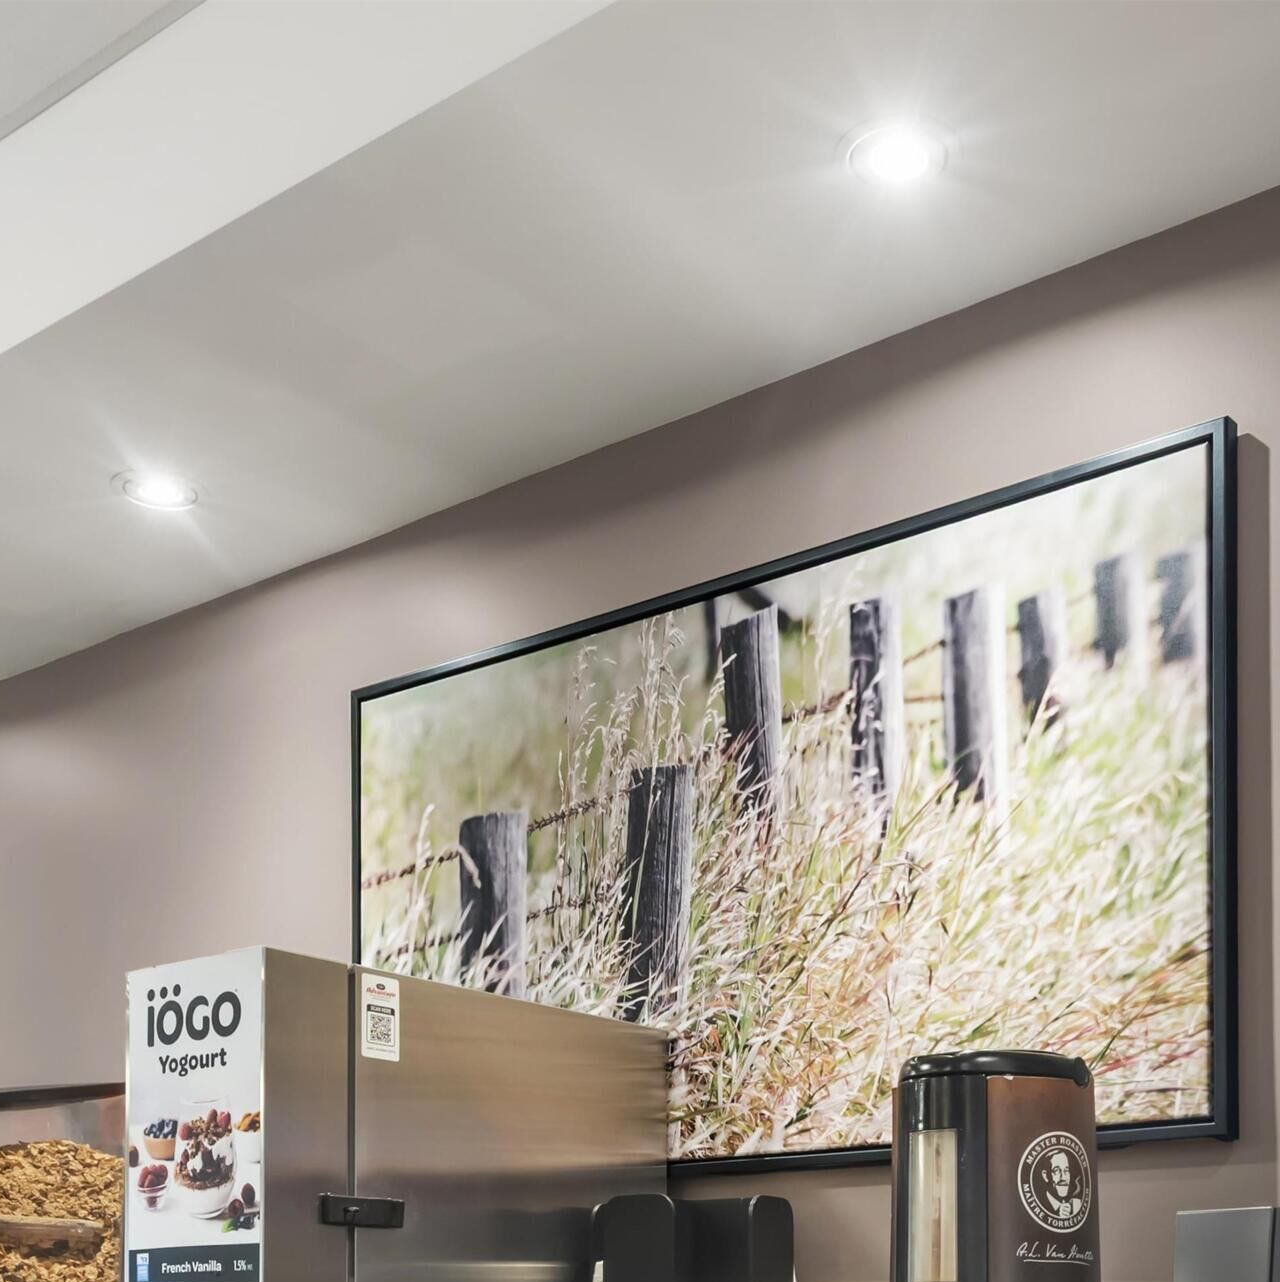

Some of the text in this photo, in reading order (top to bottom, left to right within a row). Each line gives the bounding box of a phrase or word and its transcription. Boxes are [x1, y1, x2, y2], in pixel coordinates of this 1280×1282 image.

[158, 1047, 228, 1077] Yogourt
[1026, 1136, 1088, 1169] MASTER ROASTER
[1046, 1243, 1067, 1259] Van
[161, 1260, 192, 1274] French
[191, 1259, 222, 1273] Vanilla
